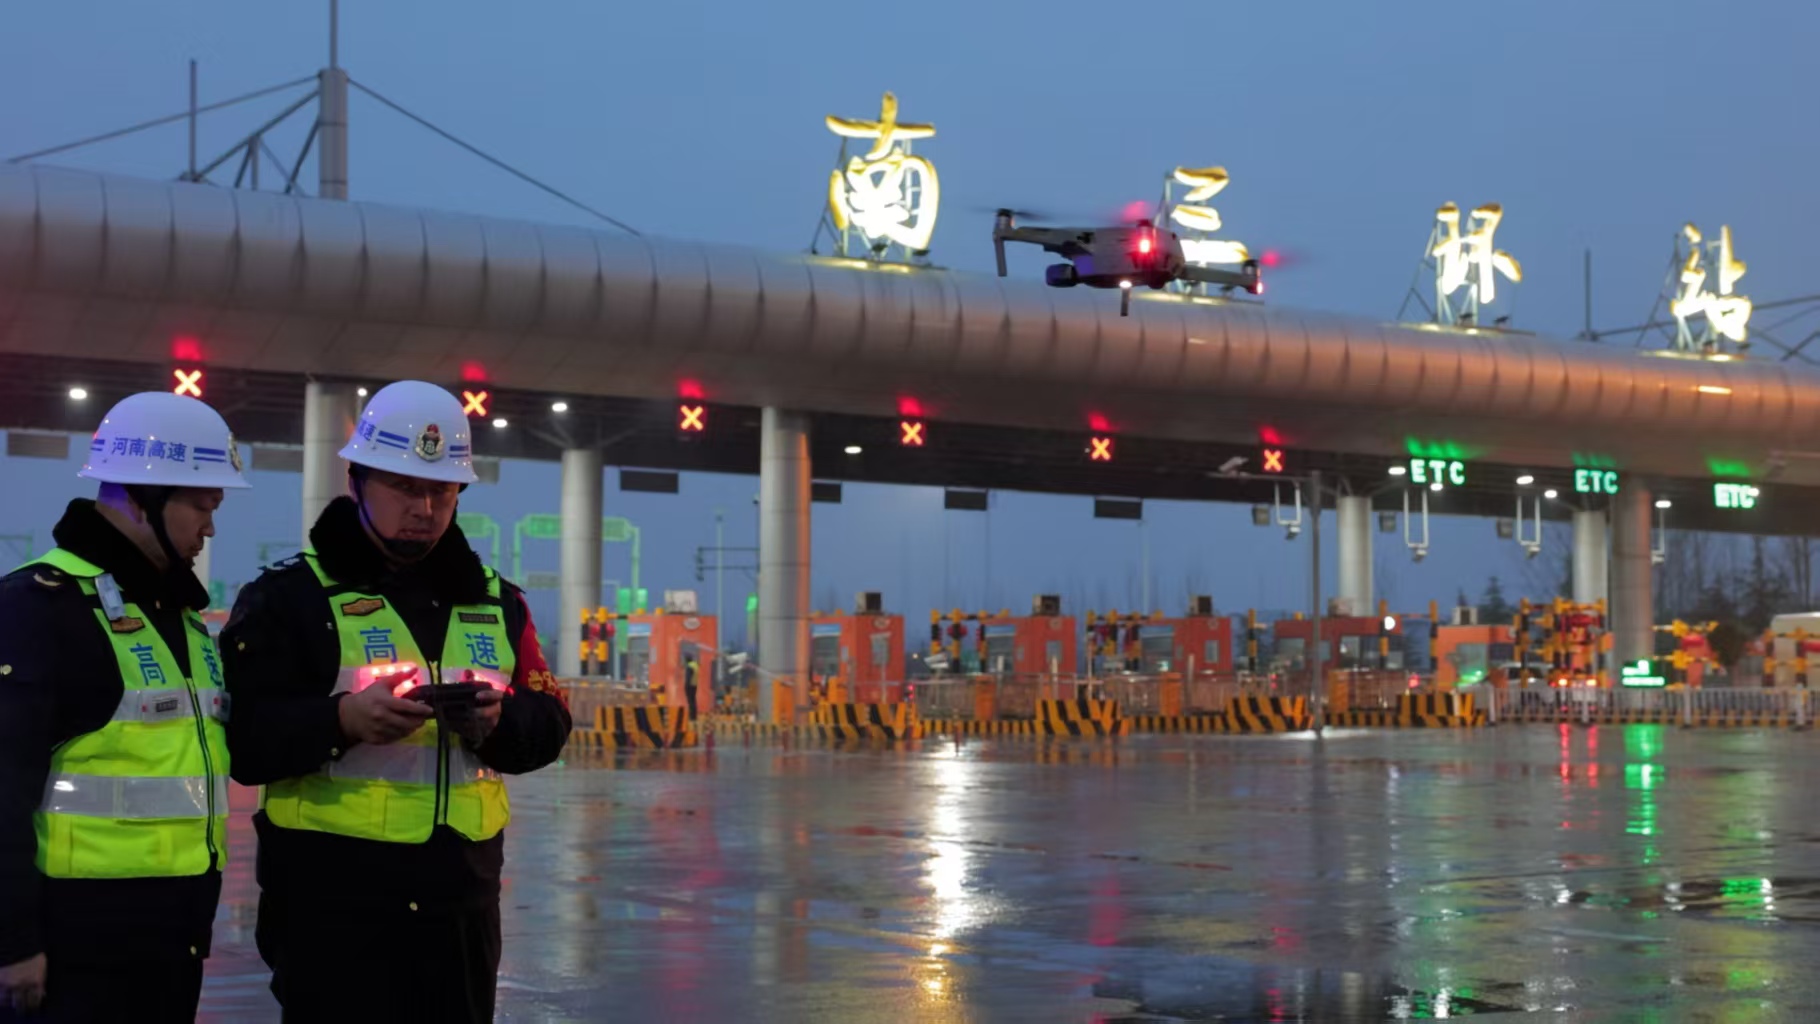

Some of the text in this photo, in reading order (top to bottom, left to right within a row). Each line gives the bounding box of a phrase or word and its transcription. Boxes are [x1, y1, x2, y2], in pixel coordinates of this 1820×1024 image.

[112, 437, 188, 463] 河南高速
[1410, 459, 1465, 485] ETC
[1575, 469, 1618, 494] ETC
[1714, 483, 1754, 508] ETC
[360, 626, 500, 670] 高 速
[129, 642, 167, 686] 高
